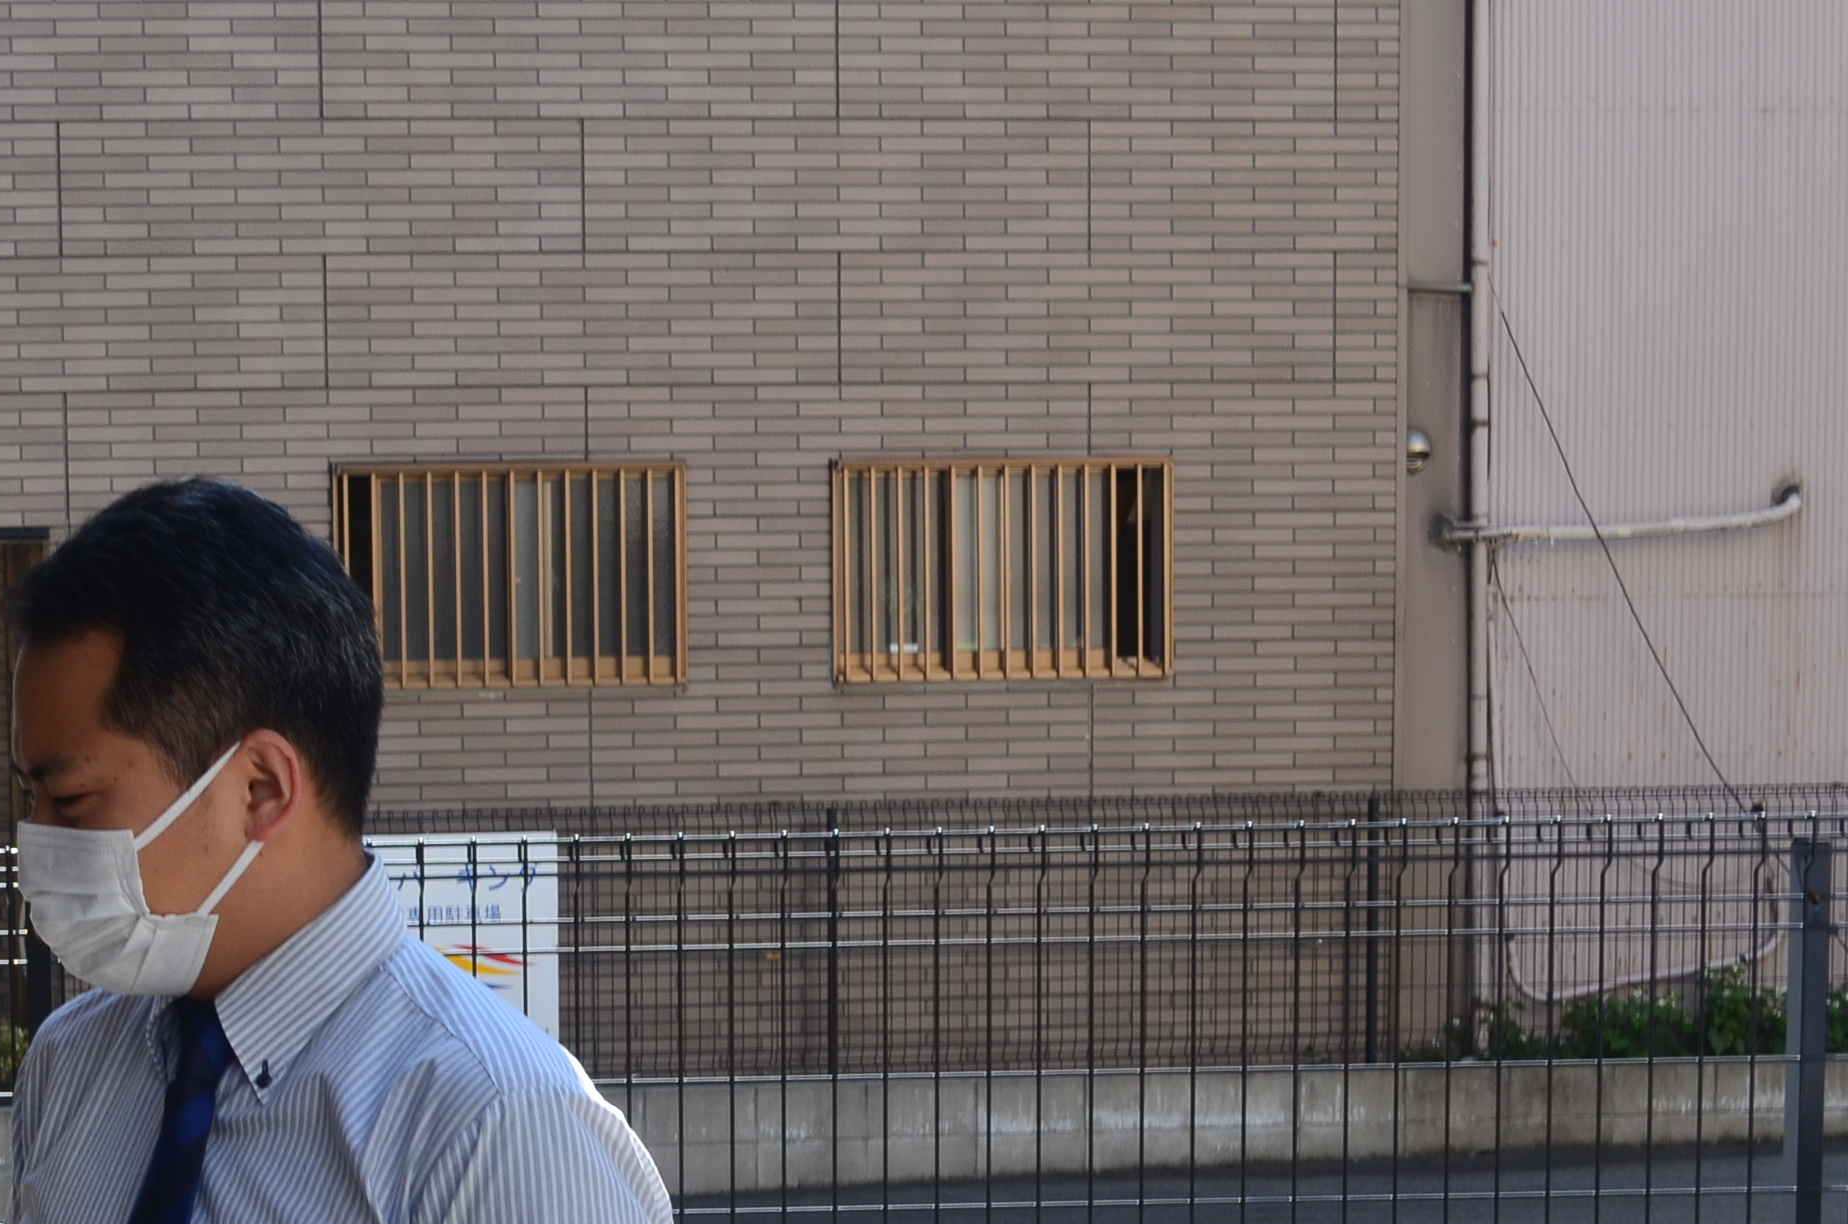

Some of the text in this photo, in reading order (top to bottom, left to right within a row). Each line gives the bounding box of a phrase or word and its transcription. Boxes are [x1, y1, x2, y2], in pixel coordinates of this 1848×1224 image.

[402, 903, 502, 923] 専用駐車場
